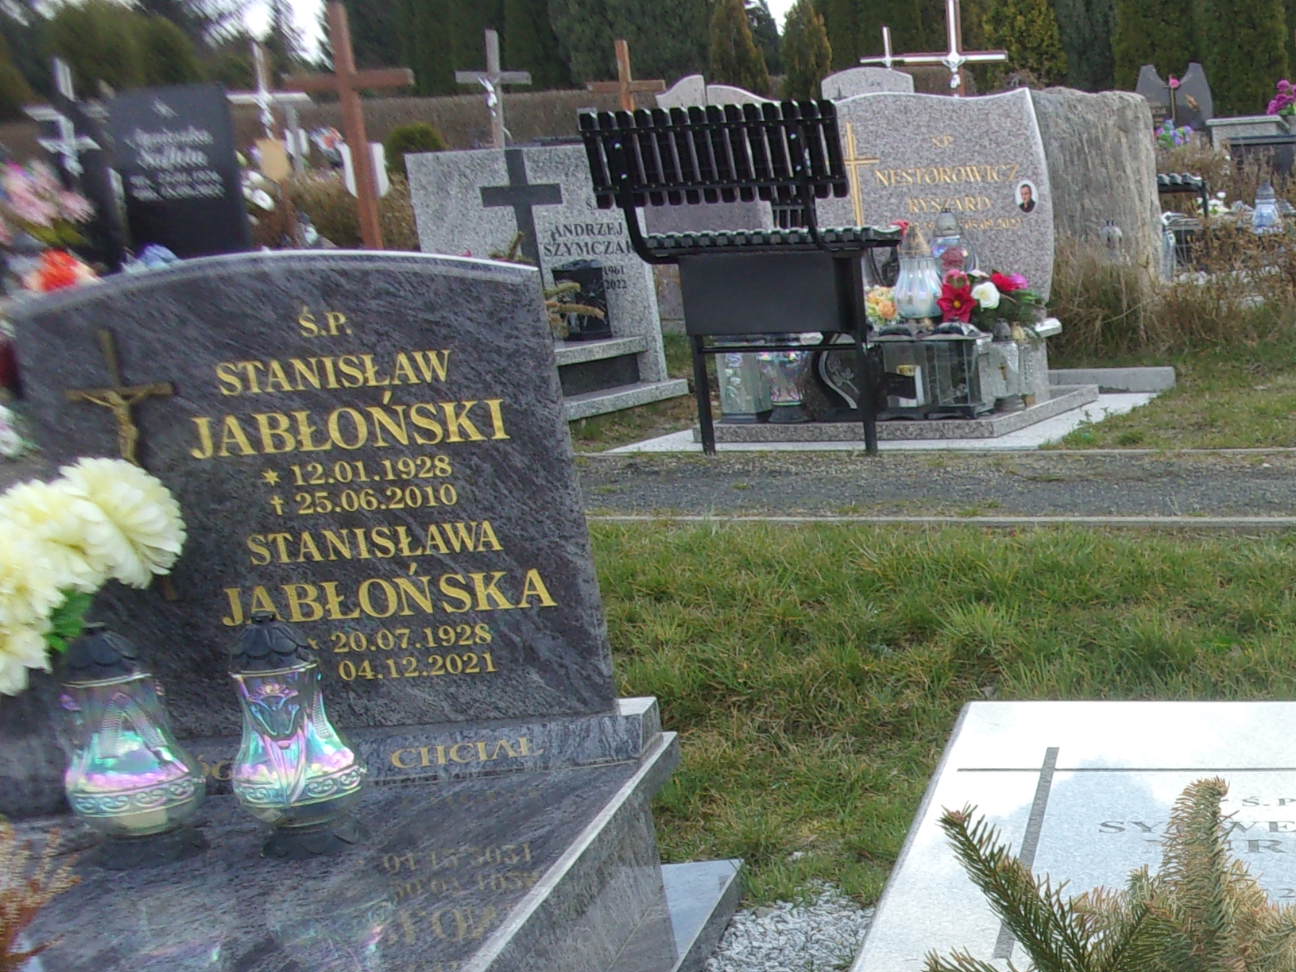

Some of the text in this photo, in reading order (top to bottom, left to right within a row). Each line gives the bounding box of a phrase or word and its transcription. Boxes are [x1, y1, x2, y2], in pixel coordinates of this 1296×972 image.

[875, 163, 1020, 186] NESTOROWICZ
[550, 222, 624, 241] ANDRZEJ
[298, 307, 352, 337] Ś.P.
[215, 349, 452, 396] STANISŁAW
[190, 390, 511, 460] JABŁOŃSKI
[290, 455, 453, 486] 12.01.1928
[295, 483, 458, 515] 25.06.2010
[246, 520, 504, 566] STANISŁAWA
[222, 562, 559, 627] JABŁOŃSKA
[330, 623, 493, 654] 20.07.1928
[338, 652, 498, 682] 04.12.2021
